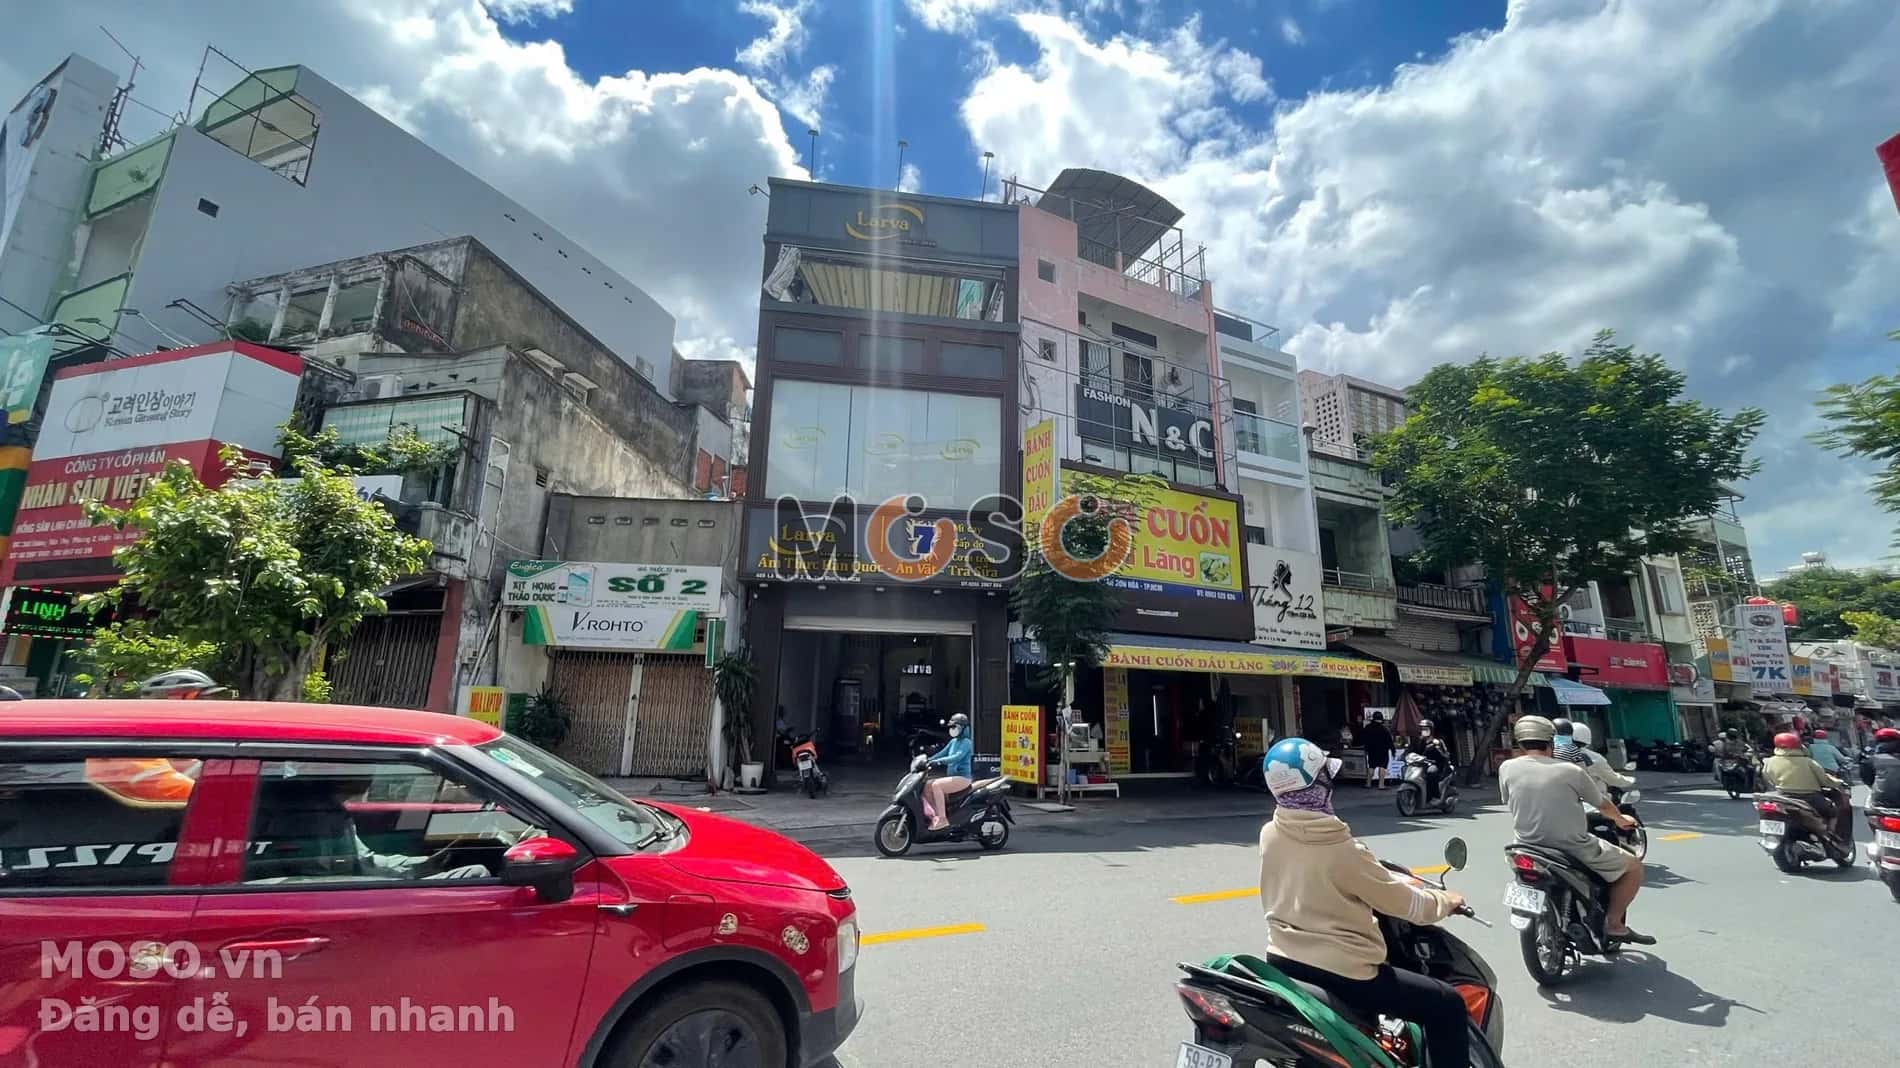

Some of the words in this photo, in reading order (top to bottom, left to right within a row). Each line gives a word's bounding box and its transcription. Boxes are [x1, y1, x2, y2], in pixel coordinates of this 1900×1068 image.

[856, 206, 909, 231] Larva
[108, 390, 197, 416] 고려인삼이야기
[1083, 388, 1131, 408] FASHION
[1131, 402, 1159, 447] N
[1165, 425, 1186, 452] &
[1188, 420, 1213, 458] C
[1146, 501, 1231, 548] CUỐN
[1143, 544, 1195, 578] Lăng
[680, 580, 706, 595] 2
[1294, 593, 1314, 612] 12
[1751, 666, 1787, 680] 7K
